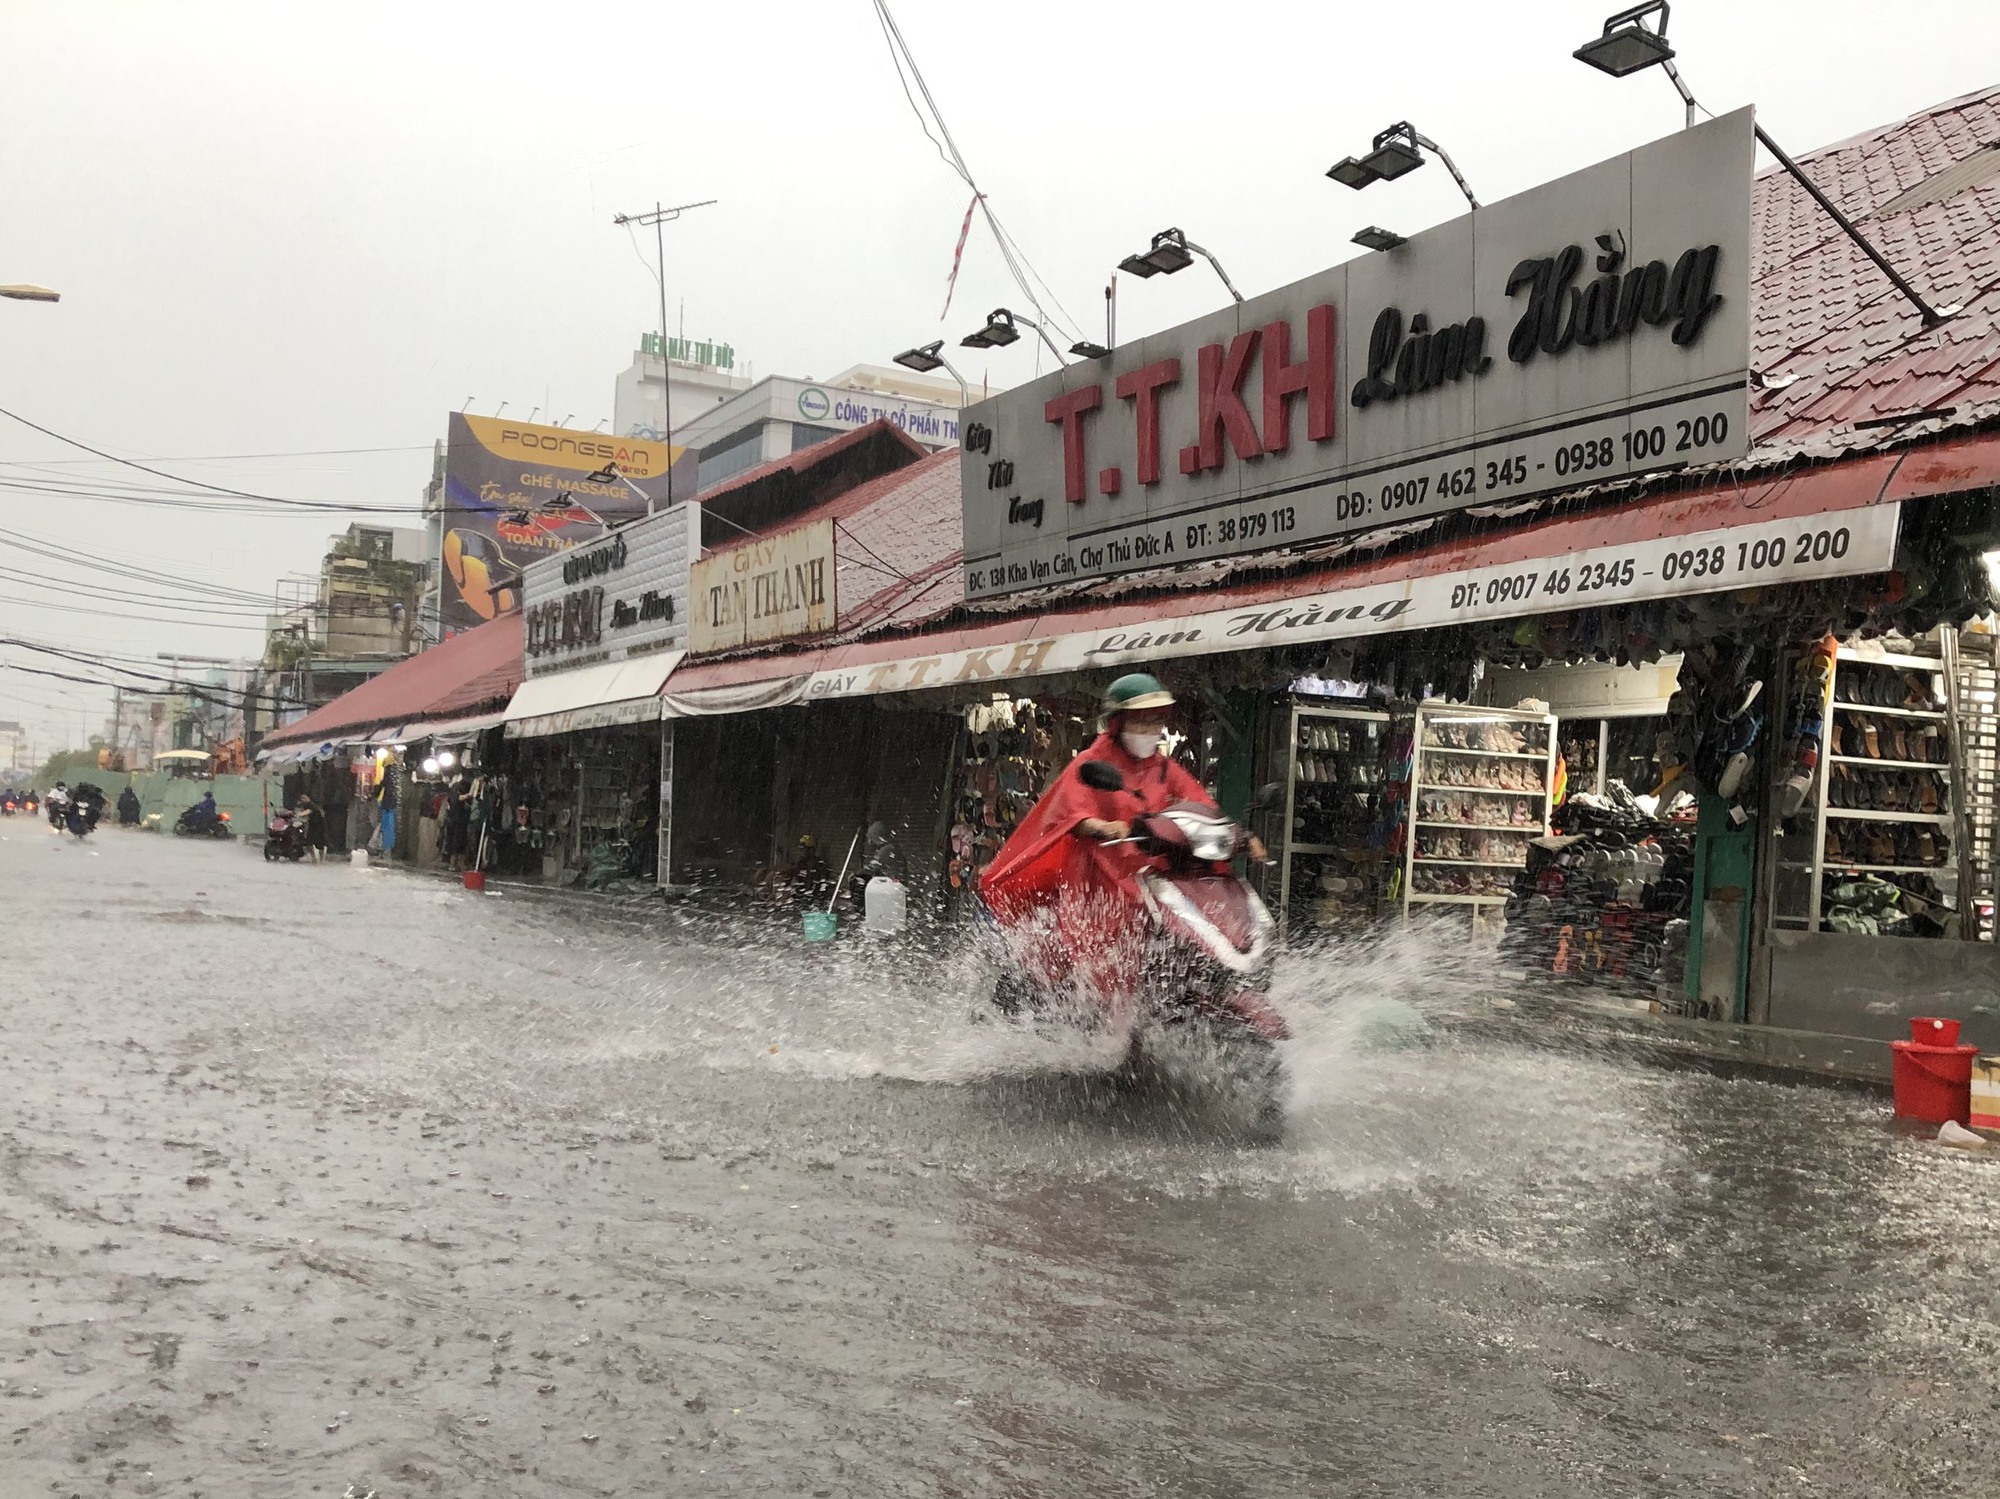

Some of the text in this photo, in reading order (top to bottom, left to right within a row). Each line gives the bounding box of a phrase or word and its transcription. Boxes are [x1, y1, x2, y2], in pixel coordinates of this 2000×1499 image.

[835, 398, 868, 424] CÔNG
[1044, 303, 1337, 504] T.T.KH
[556, 478, 629, 500] MASSAGE
[969, 572, 986, 592] ĐC:
[989, 567, 1006, 587] 138
[1008, 562, 1028, 584] Kha
[1030, 559, 1050, 583] Vạn
[1053, 552, 1078, 576] Cân,
[1080, 546, 1104, 571] Chợ
[1107, 537, 1131, 564] Thủ
[1135, 533, 1161, 559] Đức
[1164, 530, 1175, 553] A
[1186, 523, 1212, 549] ĐT:
[1218, 519, 1236, 543] 38
[1239, 512, 1267, 539] 979
[1272, 506, 1295, 533] 113
[1336, 490, 1373, 520] DĐ:
[1381, 477, 1430, 512] 0907
[1436, 466, 1476, 499] 462
[1485, 455, 1527, 490] 345
[1555, 436, 1614, 476] 0938
[1621, 425, 1665, 462] 100
[1675, 412, 1728, 452] 200
[752, 554, 826, 620] THÀNH
[810, 673, 858, 696] GIÀY
[1083, 629, 1206, 657] Lâm
[1226, 597, 1416, 638] Hằng
[1451, 583, 1480, 609] ĐT:
[1486, 572, 1538, 605] 0907
[1543, 567, 1570, 596] 46
[1576, 558, 1635, 592] 2345
[1662, 545, 1725, 582] 0938
[1737, 537, 1786, 572] 100
[1794, 527, 1850, 564] 200
